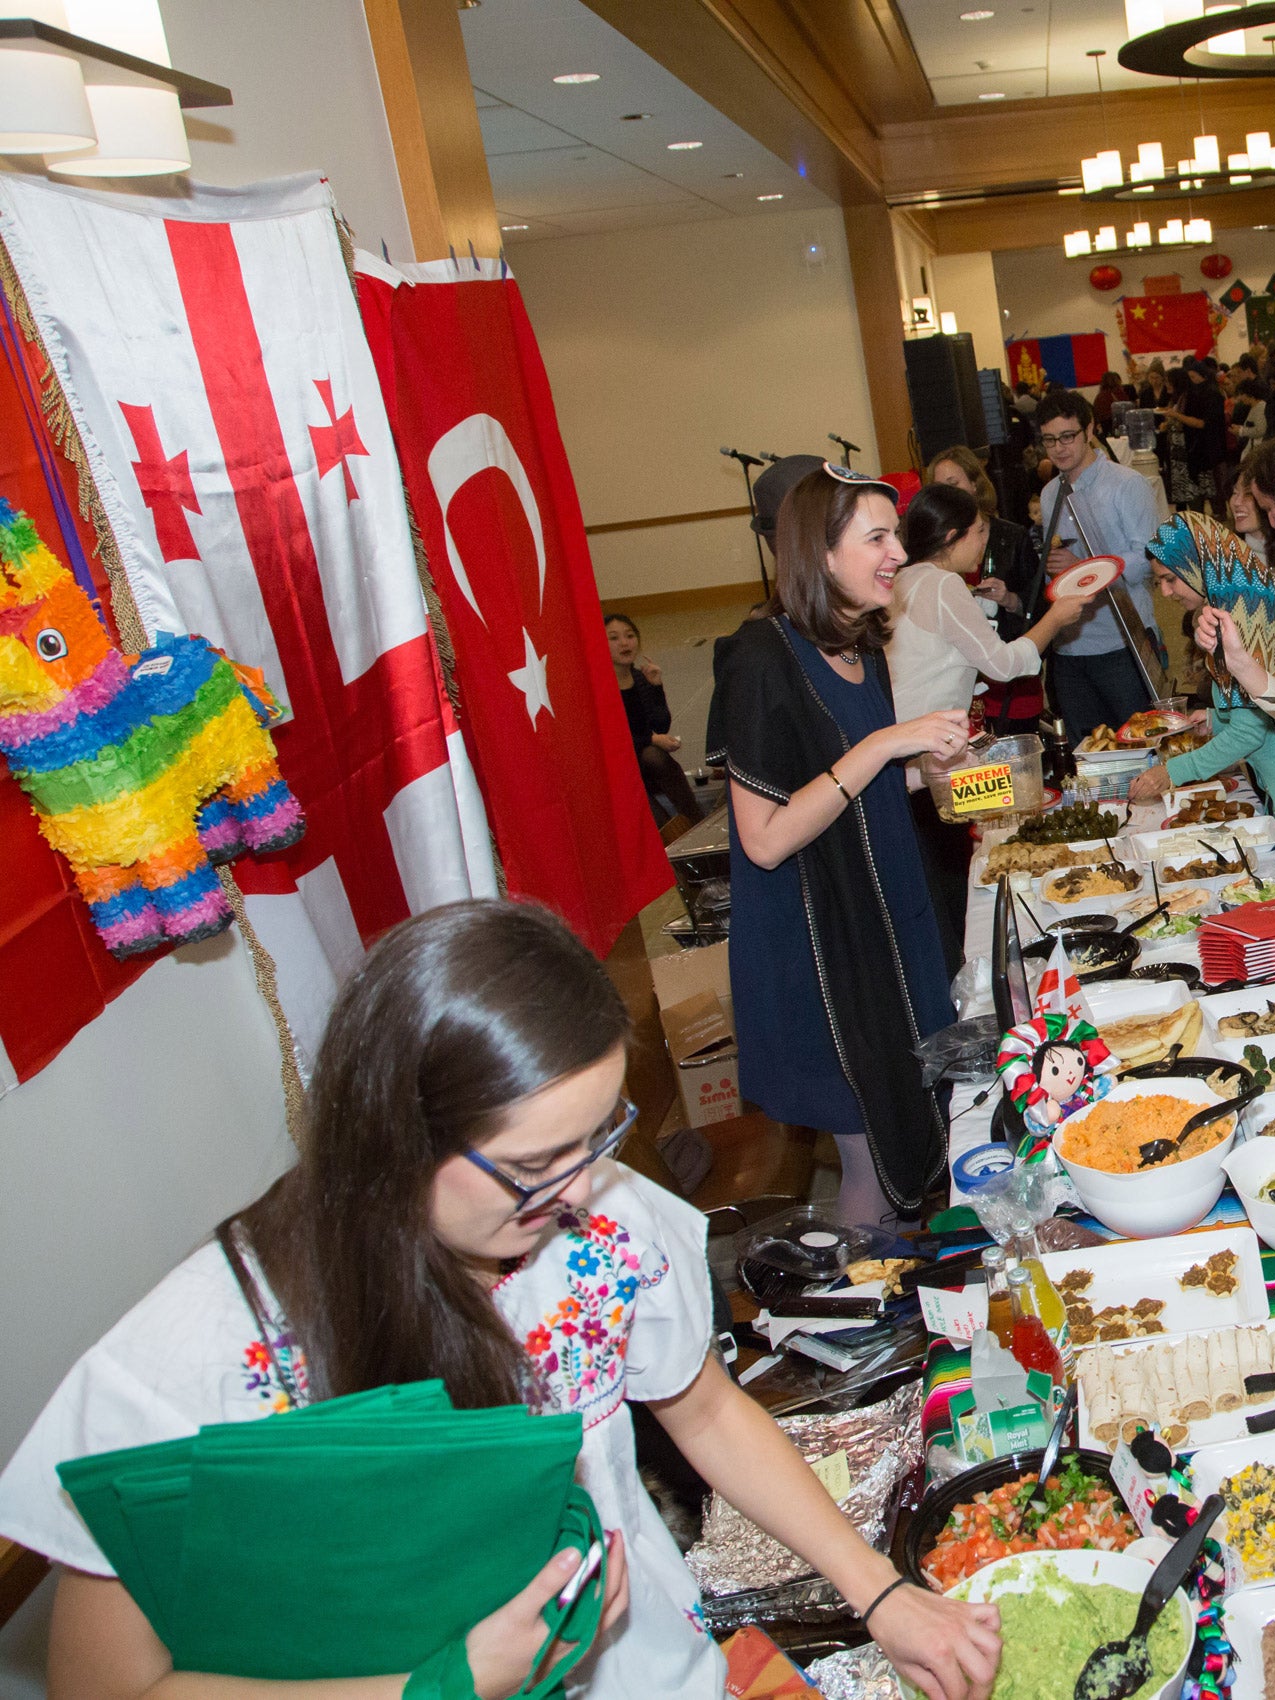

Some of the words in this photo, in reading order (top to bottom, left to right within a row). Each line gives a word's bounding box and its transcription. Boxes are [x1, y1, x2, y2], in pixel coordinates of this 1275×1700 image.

[951, 766, 1010, 787] EXTREME
[952, 775, 1013, 799] VALUE!
[1007, 1428, 1029, 1440] Royal
[1010, 1439, 1028, 1450] Mint
